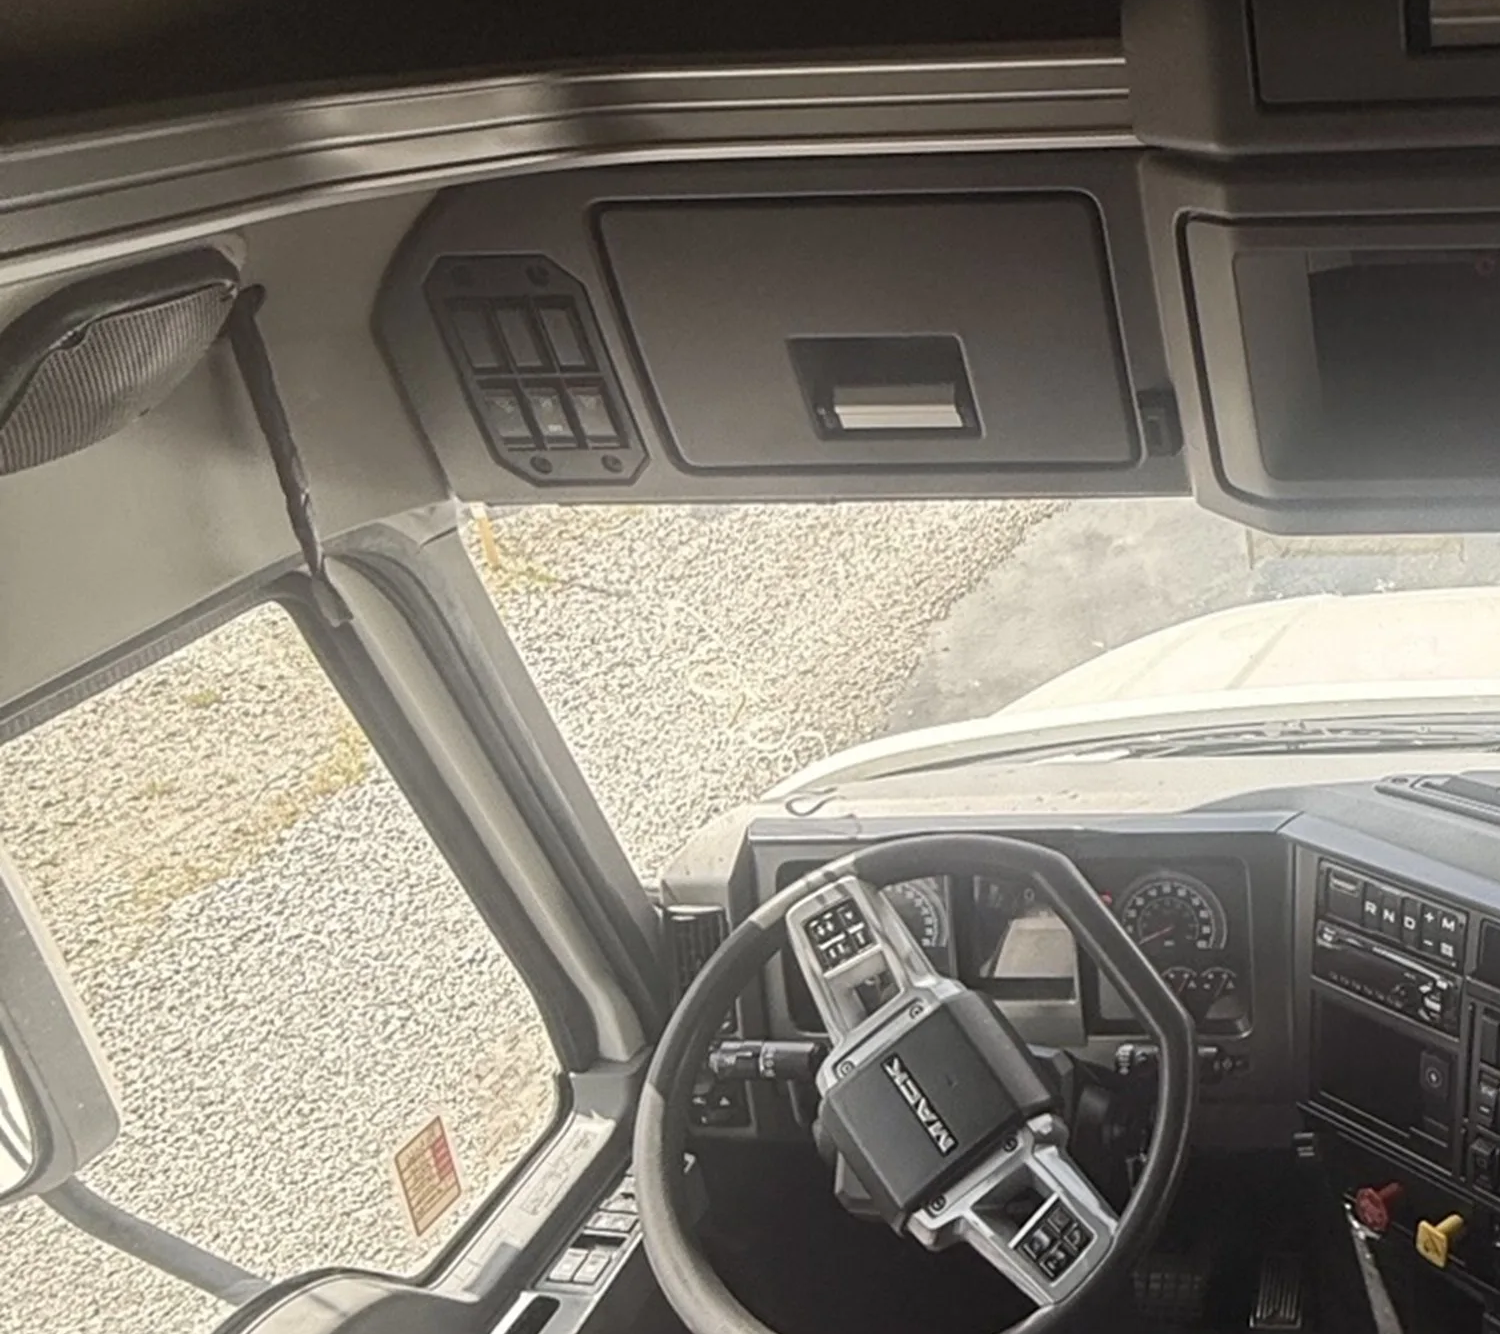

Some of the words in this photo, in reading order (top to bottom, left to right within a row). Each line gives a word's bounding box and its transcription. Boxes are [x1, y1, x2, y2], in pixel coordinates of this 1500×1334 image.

[1364, 900, 1377, 915] R
[1383, 908, 1396, 923] N
[1403, 916, 1416, 930] D
[1441, 917, 1456, 932] M
[882, 1056, 956, 1154] MACK
